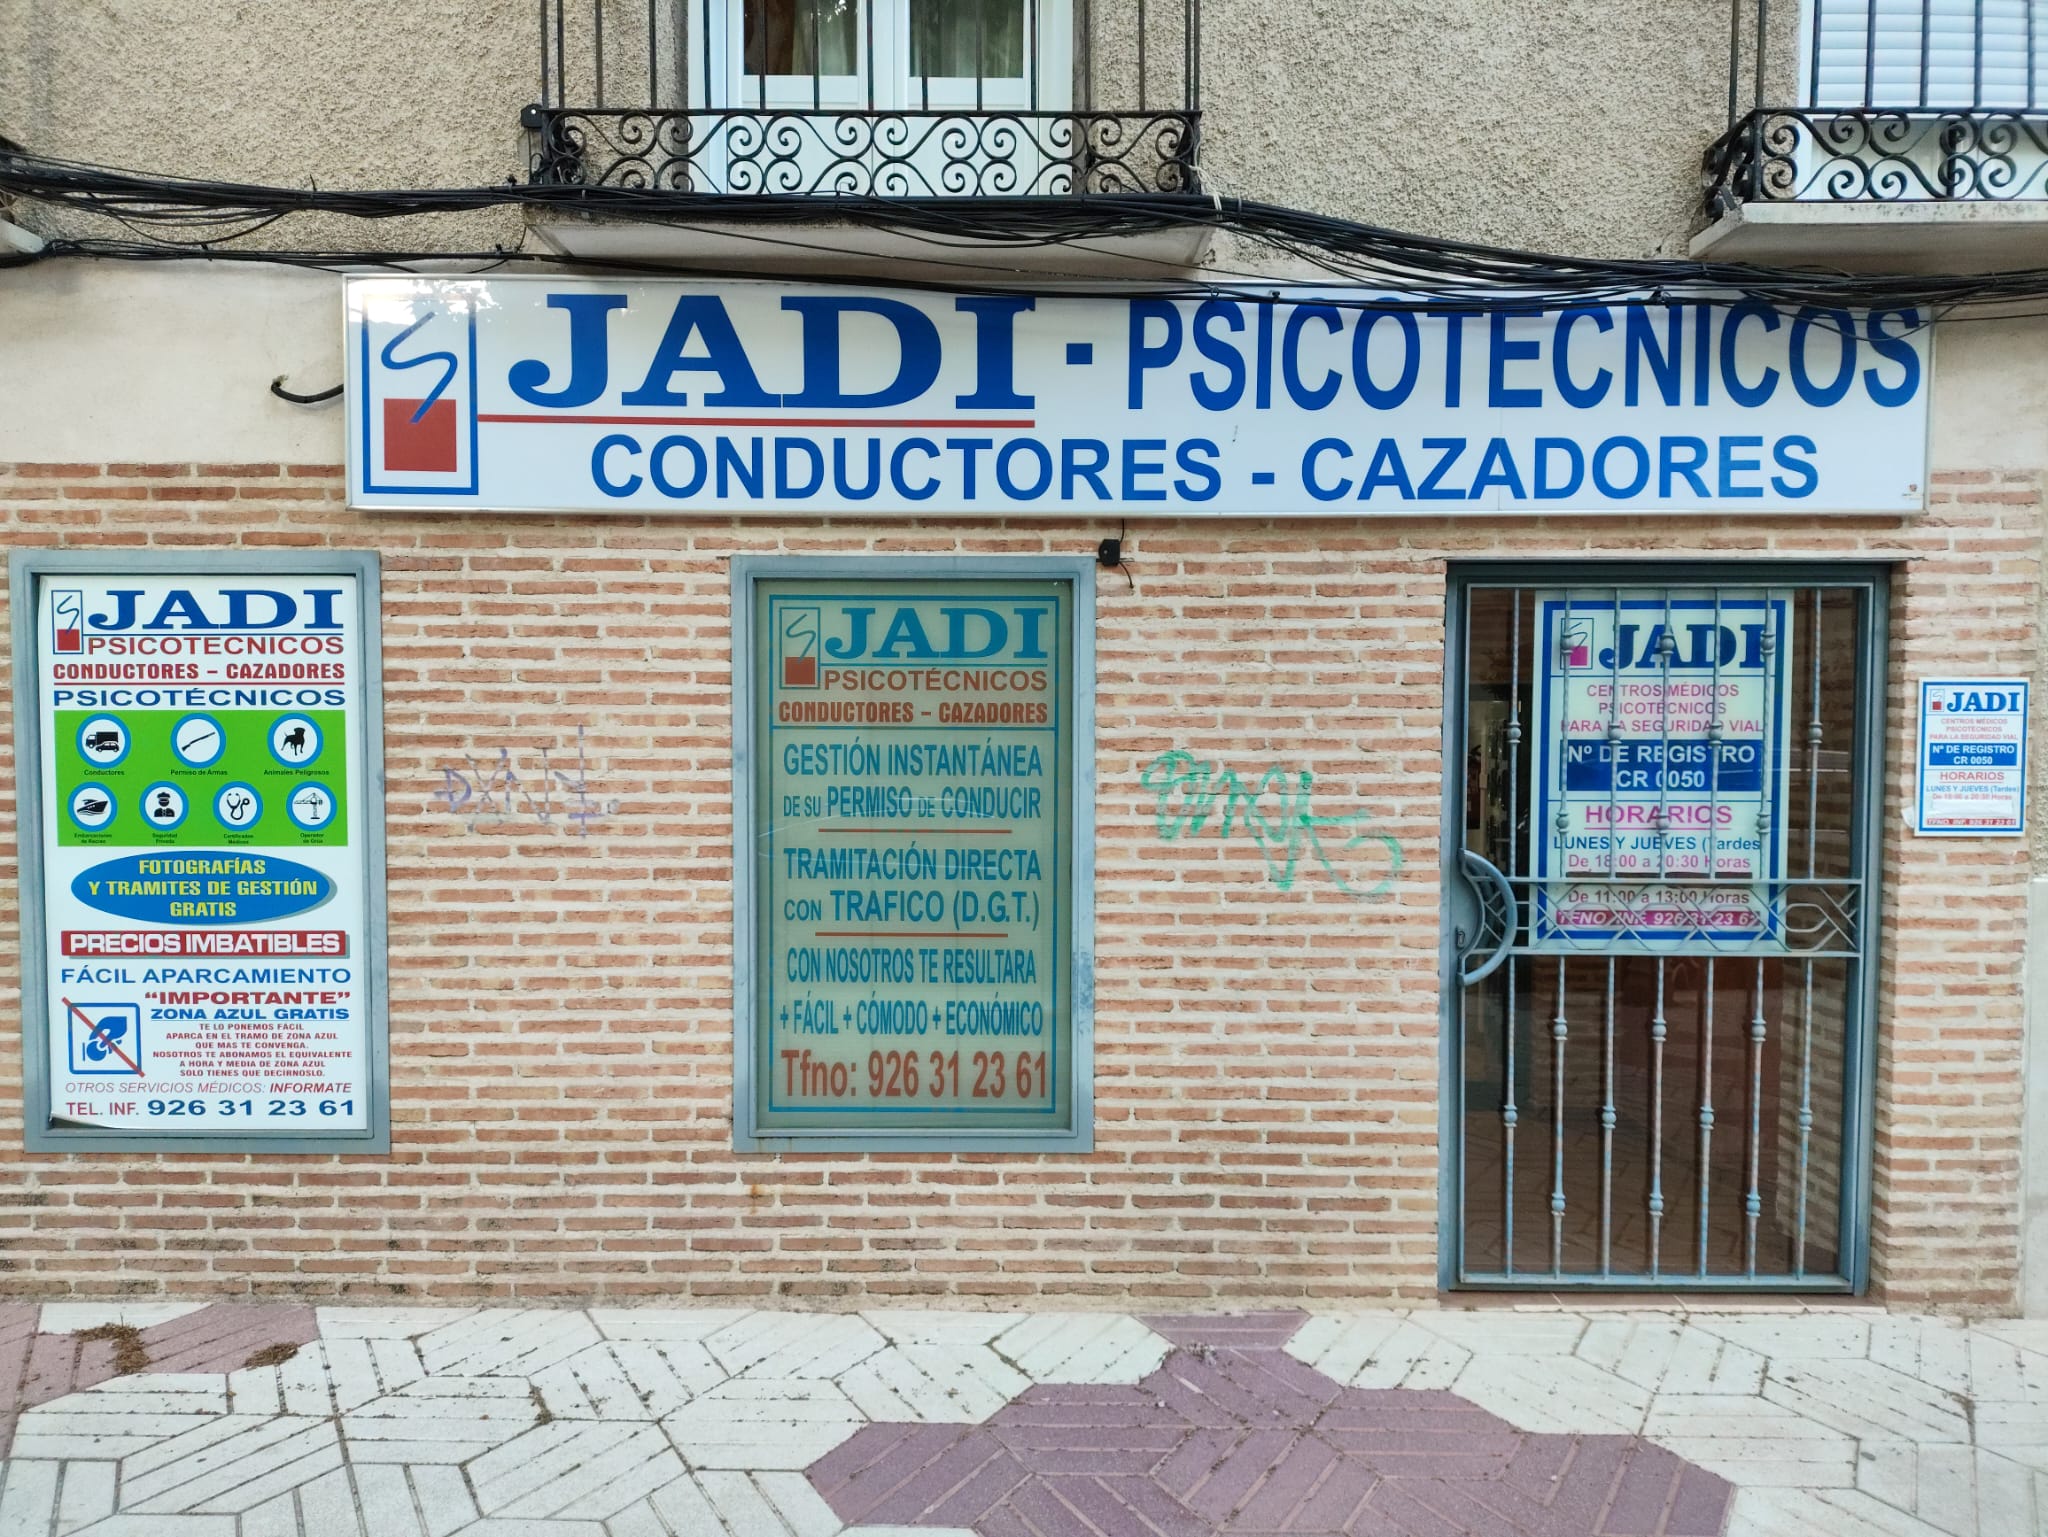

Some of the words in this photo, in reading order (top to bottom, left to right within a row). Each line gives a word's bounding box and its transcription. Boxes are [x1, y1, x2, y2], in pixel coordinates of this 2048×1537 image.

[508, 293, 1036, 411] JADI
[591, 434, 1221, 502] CONDUCTORES
[1301, 435, 1819, 502] CAZADORES
[88, 589, 344, 631] JADI
[825, 607, 1048, 659] JADI
[88, 636, 344, 655] PSICOTECNICOS
[1599, 624, 1766, 669] JADI
[53, 663, 199, 680] CONDUCTORES
[226, 663, 345, 680] CAZADORES
[824, 667, 1048, 692] PSICOTÉCNICOS
[53, 688, 346, 706] PSICOTÉCNICOS
[1946, 692, 2020, 712] JADI
[779, 701, 914, 723] CONDUCTORES
[939, 702, 1048, 724] CAZADORES
[1632, 720, 1723, 732] SEGURIDA
[1729, 720, 1763, 732] VIAL
[784, 736, 881, 776] GESTIÓN
[888, 737, 1043, 777] INSTANTÁNEA
[1600, 745, 1629, 763] DE
[1946, 745, 1960, 754] DE
[1963, 745, 2015, 754] REGISTRO
[1954, 756, 1968, 765] CR
[1971, 756, 1992, 765] 0050
[1617, 770, 1648, 788] CR
[1655, 770, 1705, 788] 0050
[1940, 772, 2005, 781] HORARIOS
[784, 795, 801, 817] DE
[804, 795, 821, 818] SU
[827, 786, 912, 818] PERMISO
[918, 796, 936, 818] DE
[941, 786, 1041, 819] CONDUCIR
[1586, 805, 1732, 824] HORARIOS
[1553, 836, 1610, 850] LUNES
[1615, 836, 1625, 849] Y
[1630, 836, 1696, 850] JUEVES
[1702, 836, 1761, 852] (ardes
[139, 858, 266, 876] FOTOGRAFÍAS
[784, 841, 937, 881] TRAMITACIÓN
[945, 849, 1042, 881] DIRECTA
[1569, 854, 1589, 868] De
[1595, 854, 1637, 868] 18:00
[1642, 857, 1650, 868] a
[1704, 855, 1751, 868] Horas
[88, 881, 101, 895] Y
[106, 881, 201, 896] TRAMITES
[208, 881, 231, 896] DE
[237, 878, 317, 896] GESTIÓN
[1569, 890, 1589, 903] De
[1641, 894, 1649, 904] a
[170, 902, 237, 917] GRATIS
[784, 899, 822, 921] CON
[830, 890, 945, 922] TRAFICO
[953, 890, 1039, 931] (D.G.T.)
[1715, 912, 1735, 925] 23
[70, 934, 181, 953] PRECIOS
[186, 934, 340, 953] IMBATIBLES
[61, 965, 136, 984] FÁCIL
[142, 968, 351, 984] APARCAMIENTO
[787, 948, 821, 983] CON
[826, 948, 914, 983] NOSOTROS
[919, 949, 938, 983] TE
[944, 949, 1037, 984] RESULTARA
[151, 1008, 207, 1020] ZONA
[214, 1008, 267, 1020] AZUL
[274, 1008, 349, 1020] GRATIS
[793, 990, 839, 1035] FÁCIL
[857, 991, 928, 1035] CÓMODO
[945, 991, 1043, 1036] ECONÓMICO
[781, 1049, 857, 1097] Tfno:
[868, 1050, 919, 1097] 926
[929, 1050, 959, 1097] 31
[972, 1050, 1006, 1098] 23
[1016, 1050, 1046, 1098] 61
[65, 1082, 115, 1094] OTROS
[119, 1082, 193, 1094] SERVICIOS
[197, 1081, 266, 1094] MÉDICOS:
[269, 1082, 352, 1094] INFORMATE
[66, 1102, 103, 1116] TEL.
[109, 1102, 139, 1116] INF.
[148, 1100, 206, 1116] 926
[218, 1100, 253, 1116] 31
[268, 1100, 307, 1116] 23
[319, 1100, 354, 1116] 61
